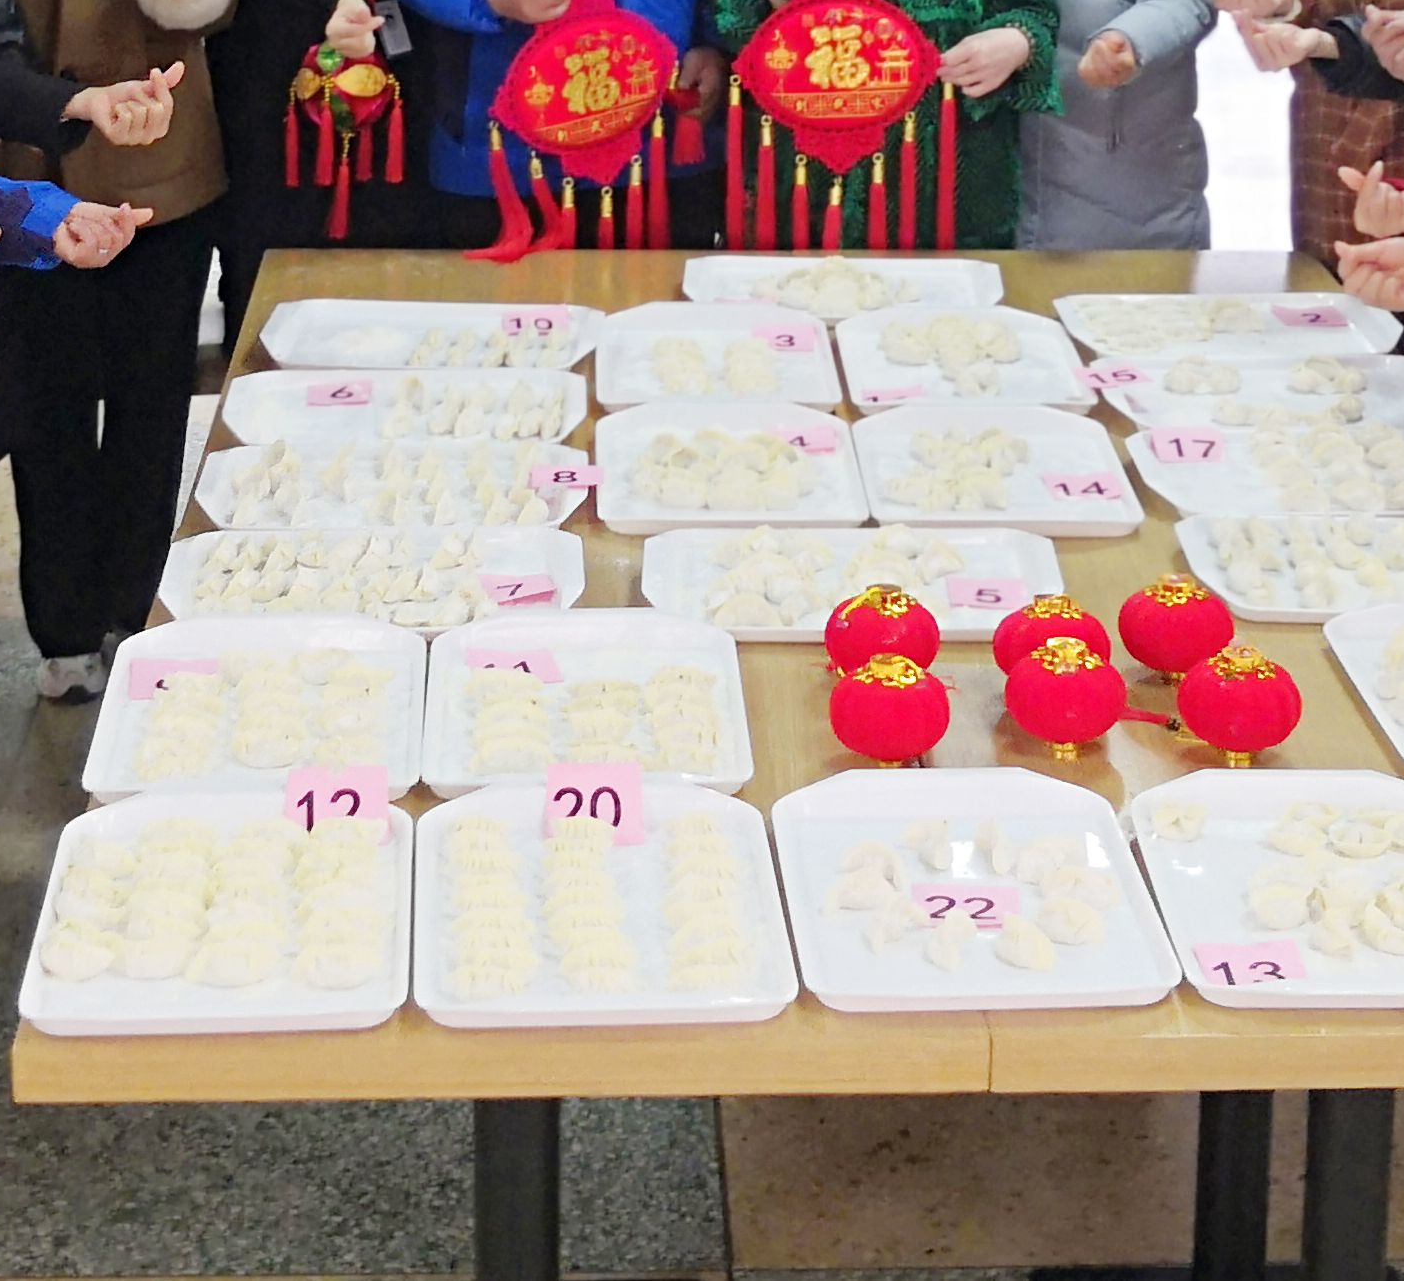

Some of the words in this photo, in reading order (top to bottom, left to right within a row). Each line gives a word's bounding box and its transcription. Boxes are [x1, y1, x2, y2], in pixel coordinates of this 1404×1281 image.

[805, 24, 870, 90] 福
[562, 46, 620, 115] 福
[774, 334, 796, 348] 3
[1088, 369, 1138, 385] 15
[329, 386, 355, 399] 6
[1167, 438, 1216, 458] 17
[552, 470, 578, 484] 8
[1054, 480, 1108, 497] 14
[496, 582, 524, 597] 7
[975, 588, 1002, 604] 5
[552, 786, 622, 828] 20
[924, 895, 995, 919] 22
[1212, 961, 1286, 985] 13
